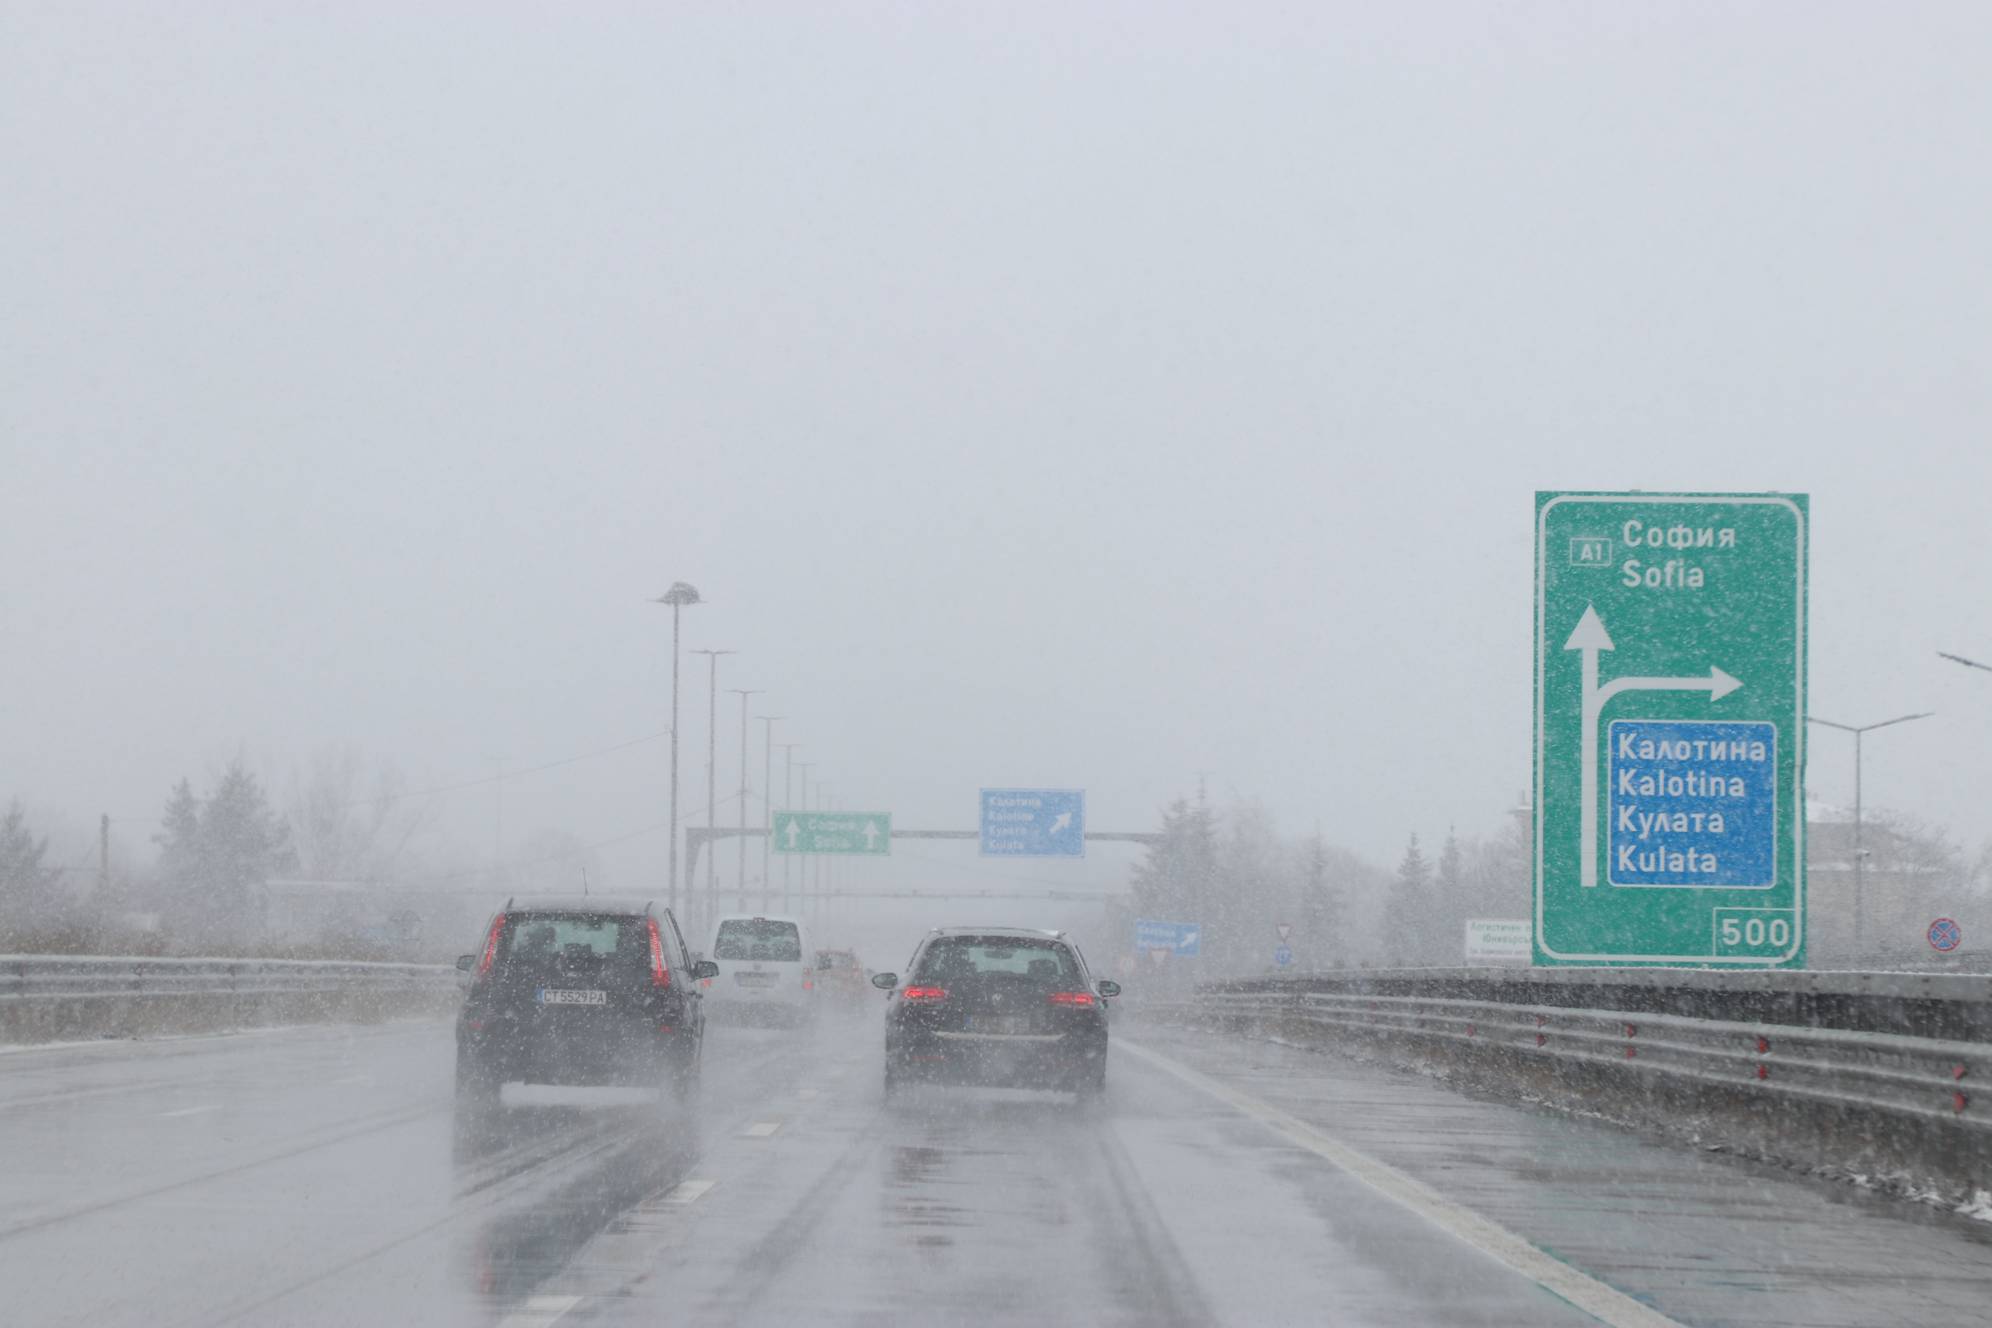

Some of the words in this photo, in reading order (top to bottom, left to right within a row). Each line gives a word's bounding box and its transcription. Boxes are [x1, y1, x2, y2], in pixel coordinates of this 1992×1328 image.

[1622, 519, 1736, 550] София
[1579, 543, 1603, 561] A1
[1622, 559, 1705, 588] Sofia
[1618, 733, 1767, 762] Калотина
[1618, 769, 1746, 798] Kalotina
[1618, 805, 1726, 841] Кулата
[1618, 844, 1718, 873] Kulata
[1722, 918, 1789, 947] 500
